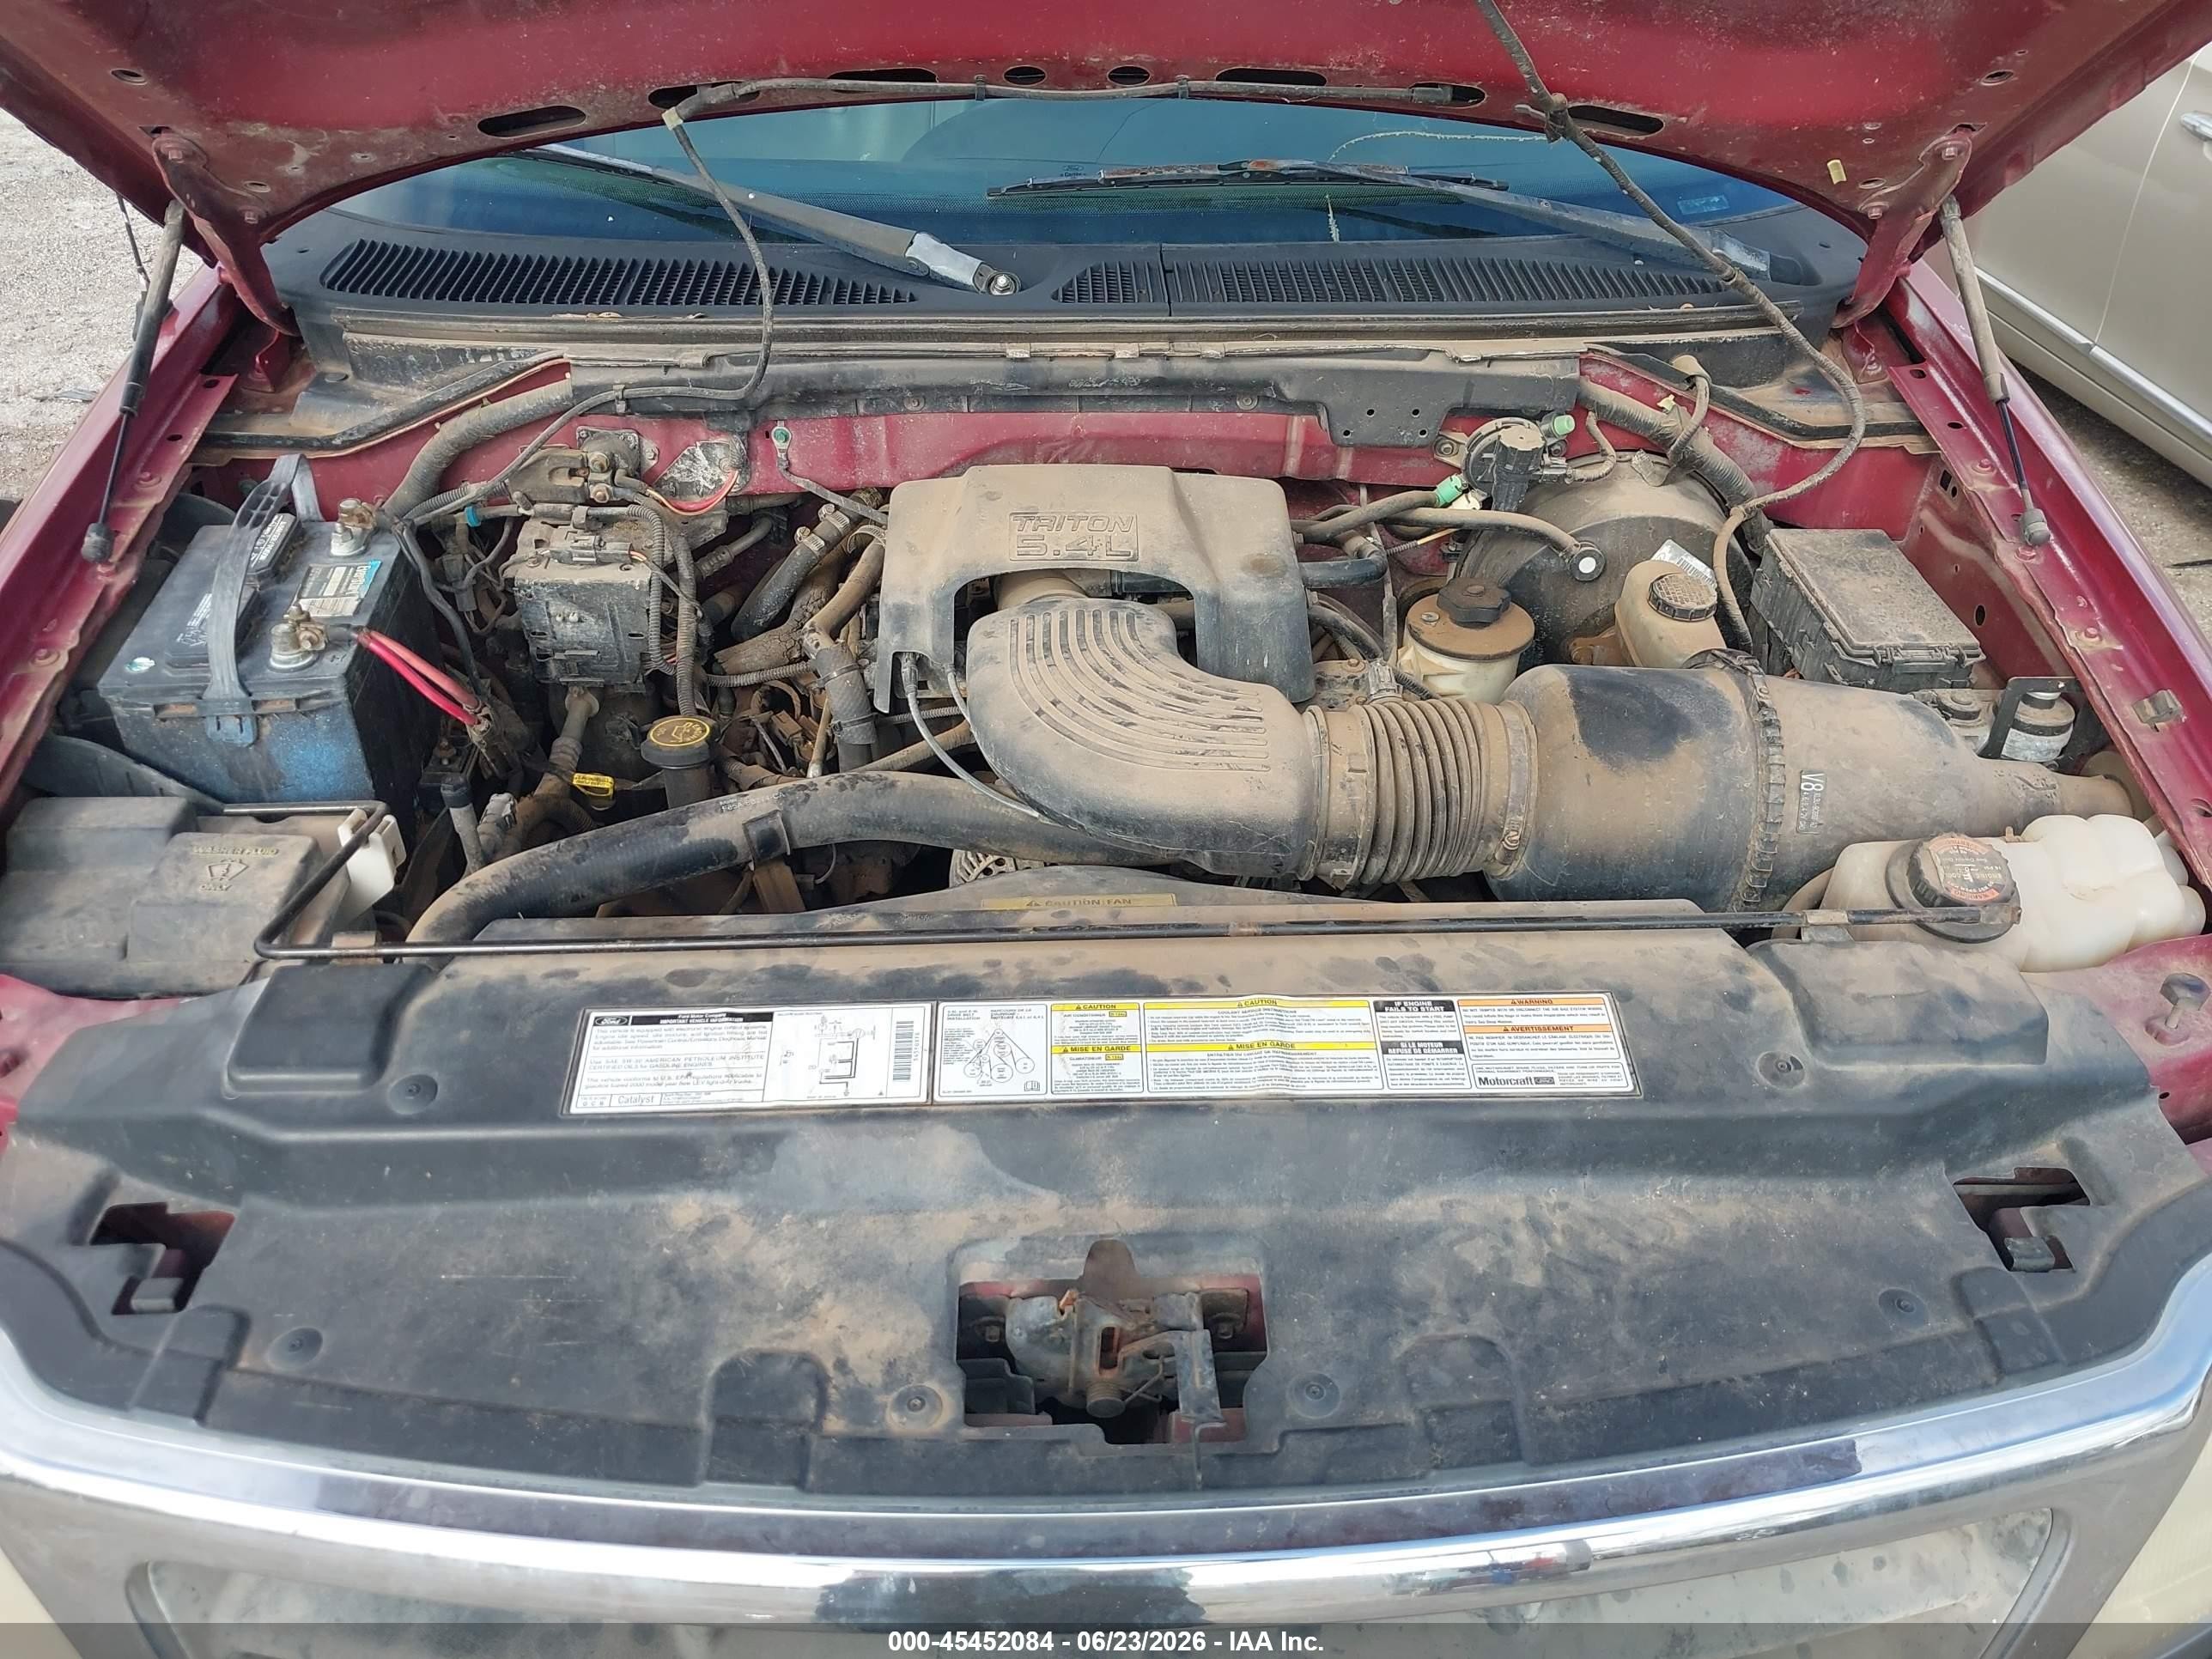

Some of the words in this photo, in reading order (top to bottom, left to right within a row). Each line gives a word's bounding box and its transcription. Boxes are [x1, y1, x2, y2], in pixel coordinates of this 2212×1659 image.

[1013, 515, 1133, 532] TRITON
[1017, 535, 1131, 556] 5.4L
[1801, 773, 1825, 791] V8
[1478, 1077, 1534, 1085] Motorcraft
[618, 1095, 654, 1106] Catalyst
